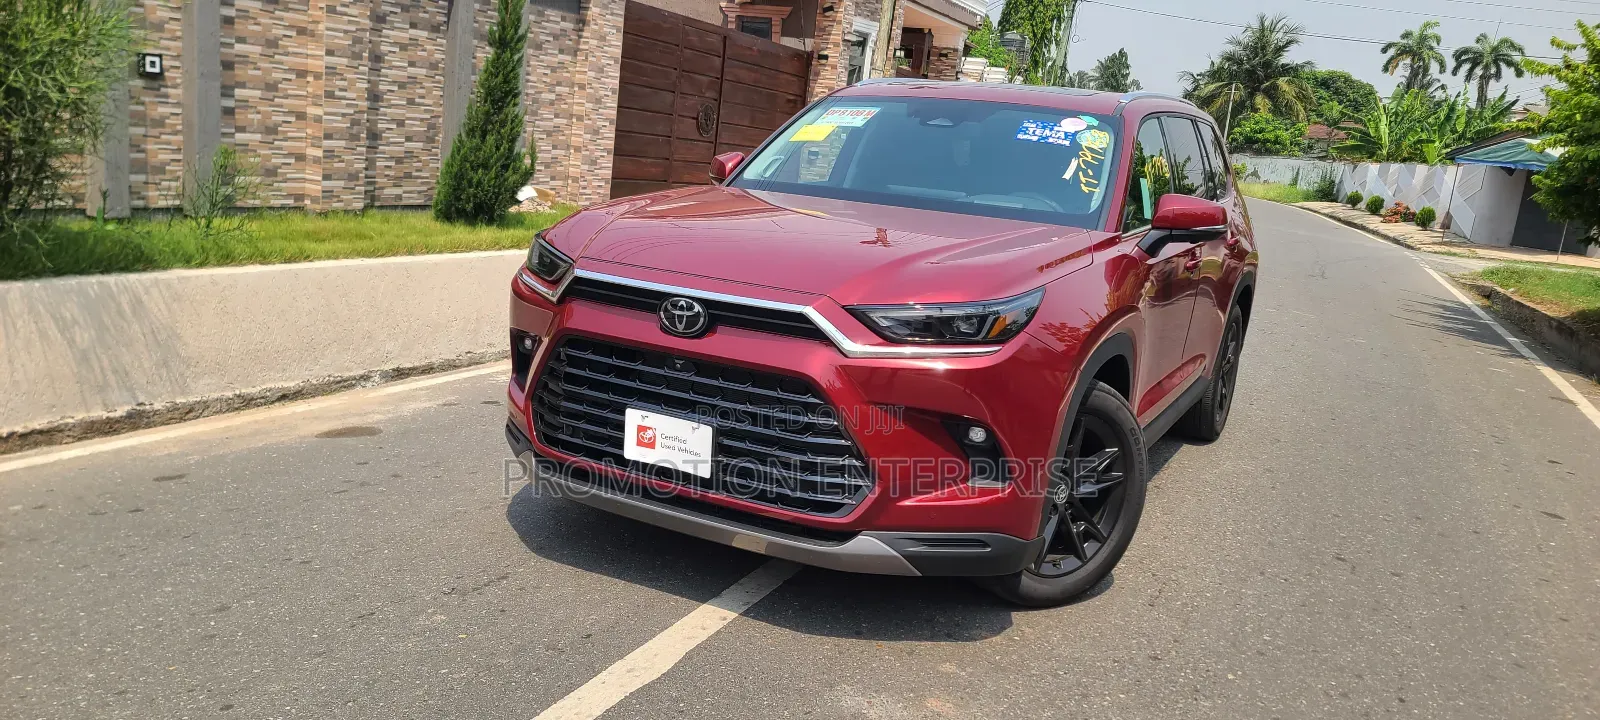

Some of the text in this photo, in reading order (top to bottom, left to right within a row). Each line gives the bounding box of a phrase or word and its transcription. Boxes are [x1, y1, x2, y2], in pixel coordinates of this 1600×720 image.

[1027, 127, 1066, 140] TEMA
[660, 433, 687, 444] Certified
[660, 442, 702, 457] Used Vehicles
